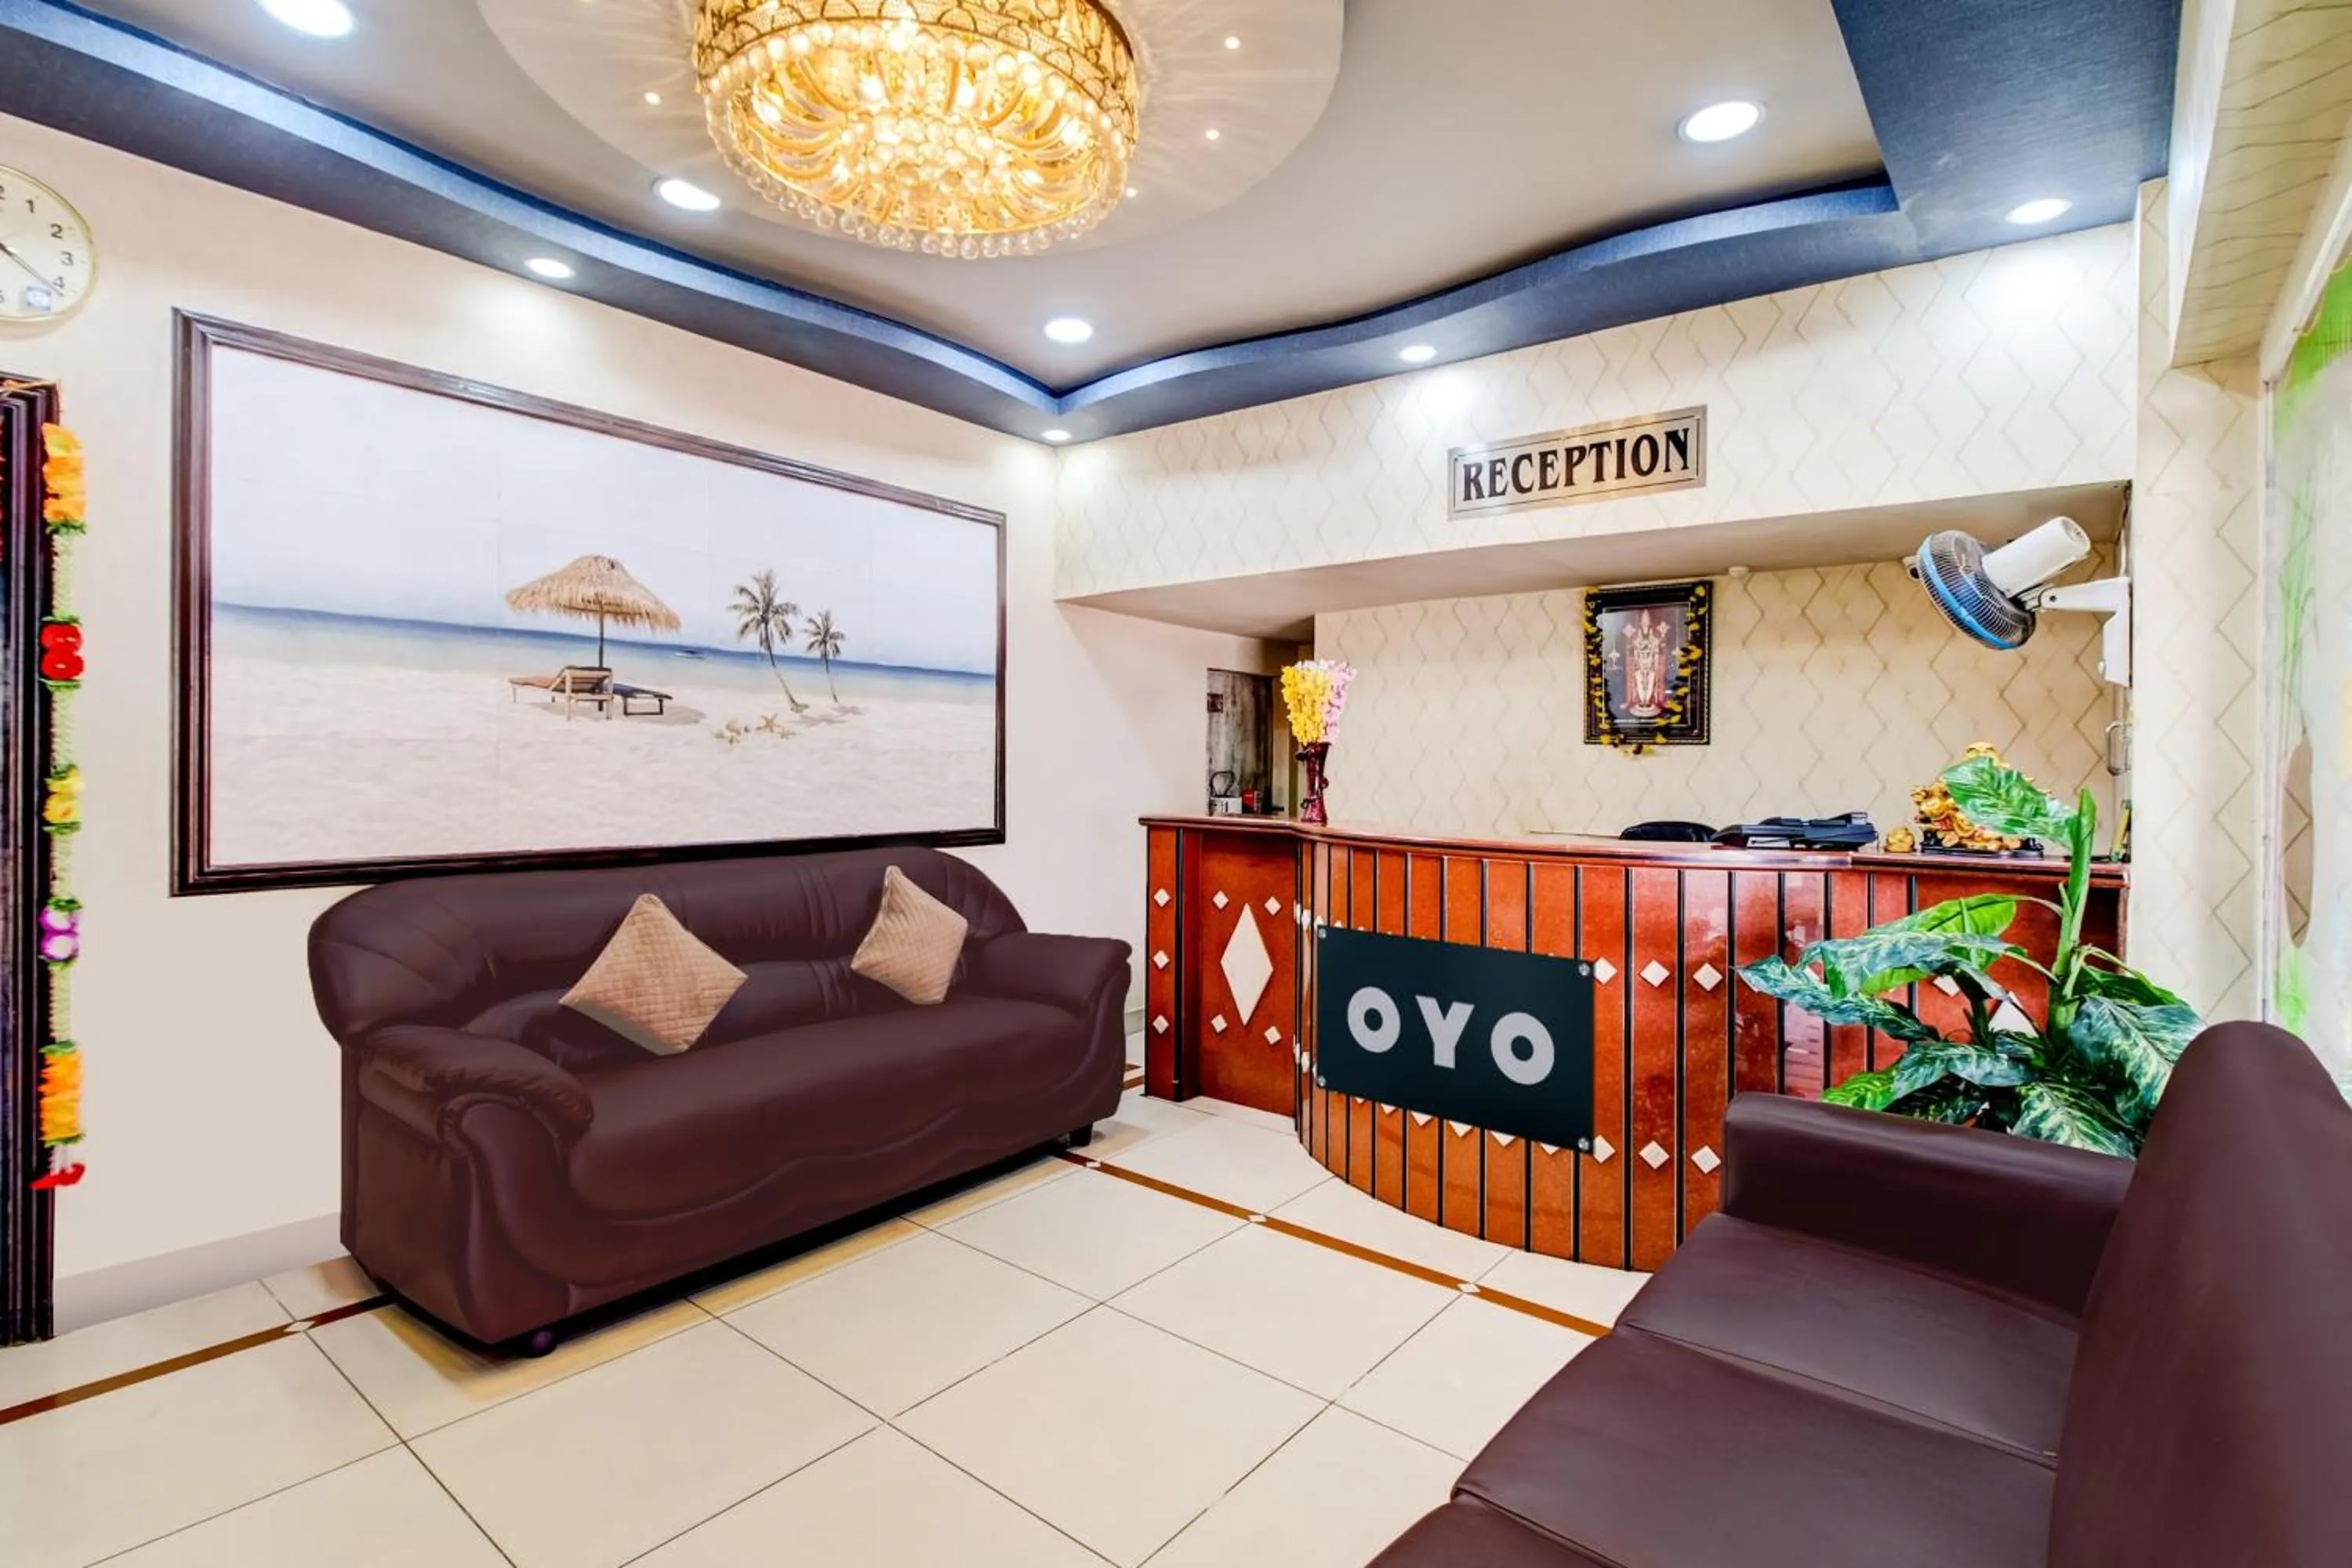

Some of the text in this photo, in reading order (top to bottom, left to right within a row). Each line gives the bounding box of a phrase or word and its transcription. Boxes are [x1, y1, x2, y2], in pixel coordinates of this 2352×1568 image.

[25, 199, 34, 213] 1
[49, 223, 63, 239] 2
[60, 250, 74, 266] 3
[53, 276, 65, 289] 4
[1462, 427, 1690, 502] RECEPTION
[1347, 985, 1555, 1086] OYO
